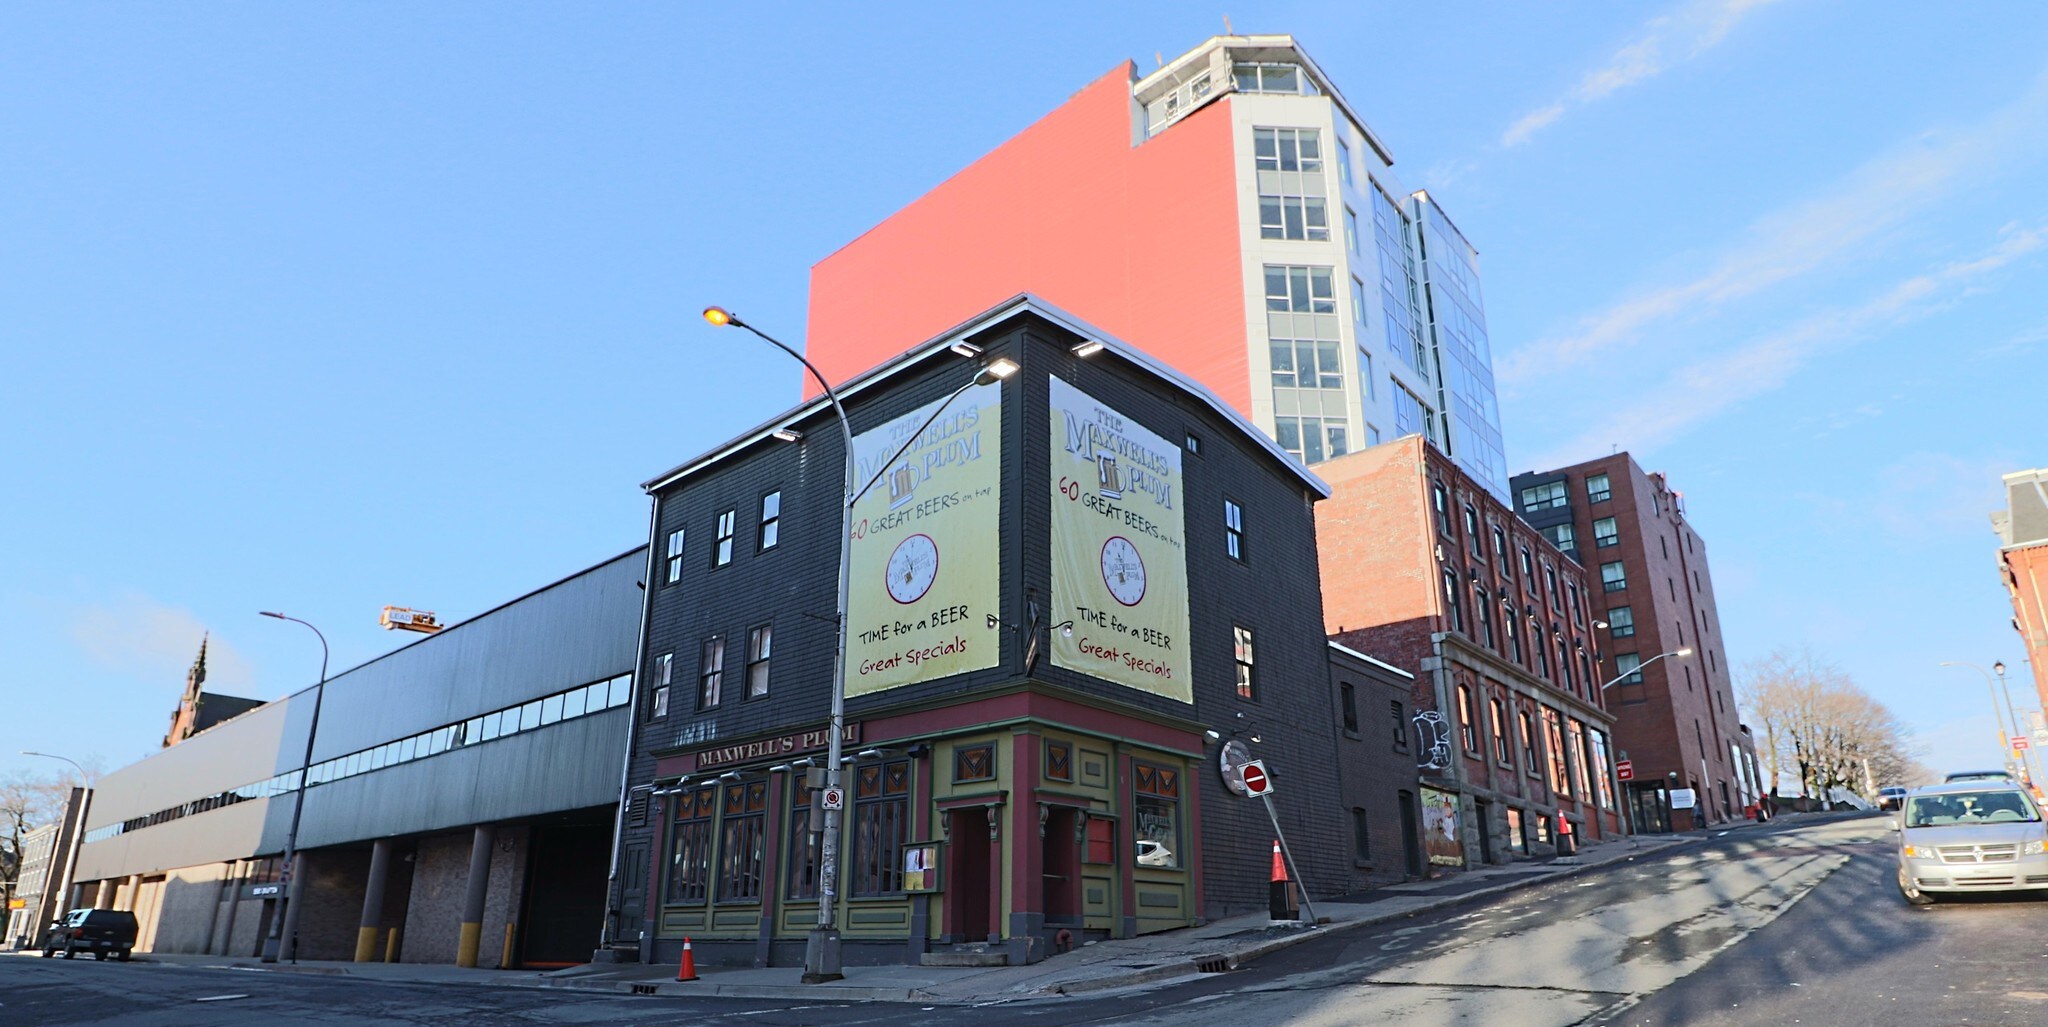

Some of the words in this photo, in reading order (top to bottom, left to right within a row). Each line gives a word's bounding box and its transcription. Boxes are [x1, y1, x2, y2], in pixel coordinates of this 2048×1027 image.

[889, 415, 921, 440] THE
[1094, 407, 1123, 433] THE
[921, 431, 982, 482] PLUM
[1062, 409, 1169, 477] MAXWELL'S
[1059, 476, 1079, 501] 60
[1082, 492, 1122, 520] GREAT
[1124, 510, 1159, 538] BEERS
[1126, 464, 1173, 510] PLUM
[850, 518, 868, 540] 60
[870, 507, 914, 534] GREAT
[916, 492, 959, 519] BEERS
[962, 494, 972, 502] on
[975, 486, 992, 498] tap
[389, 611, 411, 621] LEAD
[859, 625, 889, 645] TIME
[893, 621, 913, 636] for
[917, 619, 927, 630] a
[931, 605, 969, 628] BEER
[1077, 606, 1107, 628] TIME
[1110, 615, 1128, 633] for
[1131, 630, 1140, 639] a
[1142, 628, 1171, 650] BEER
[859, 653, 902, 676] Great
[905, 636, 967, 666] Specials
[1078, 637, 1119, 662] Great
[1122, 652, 1171, 679] Specials
[700, 736, 795, 766] MAXWELL'S
